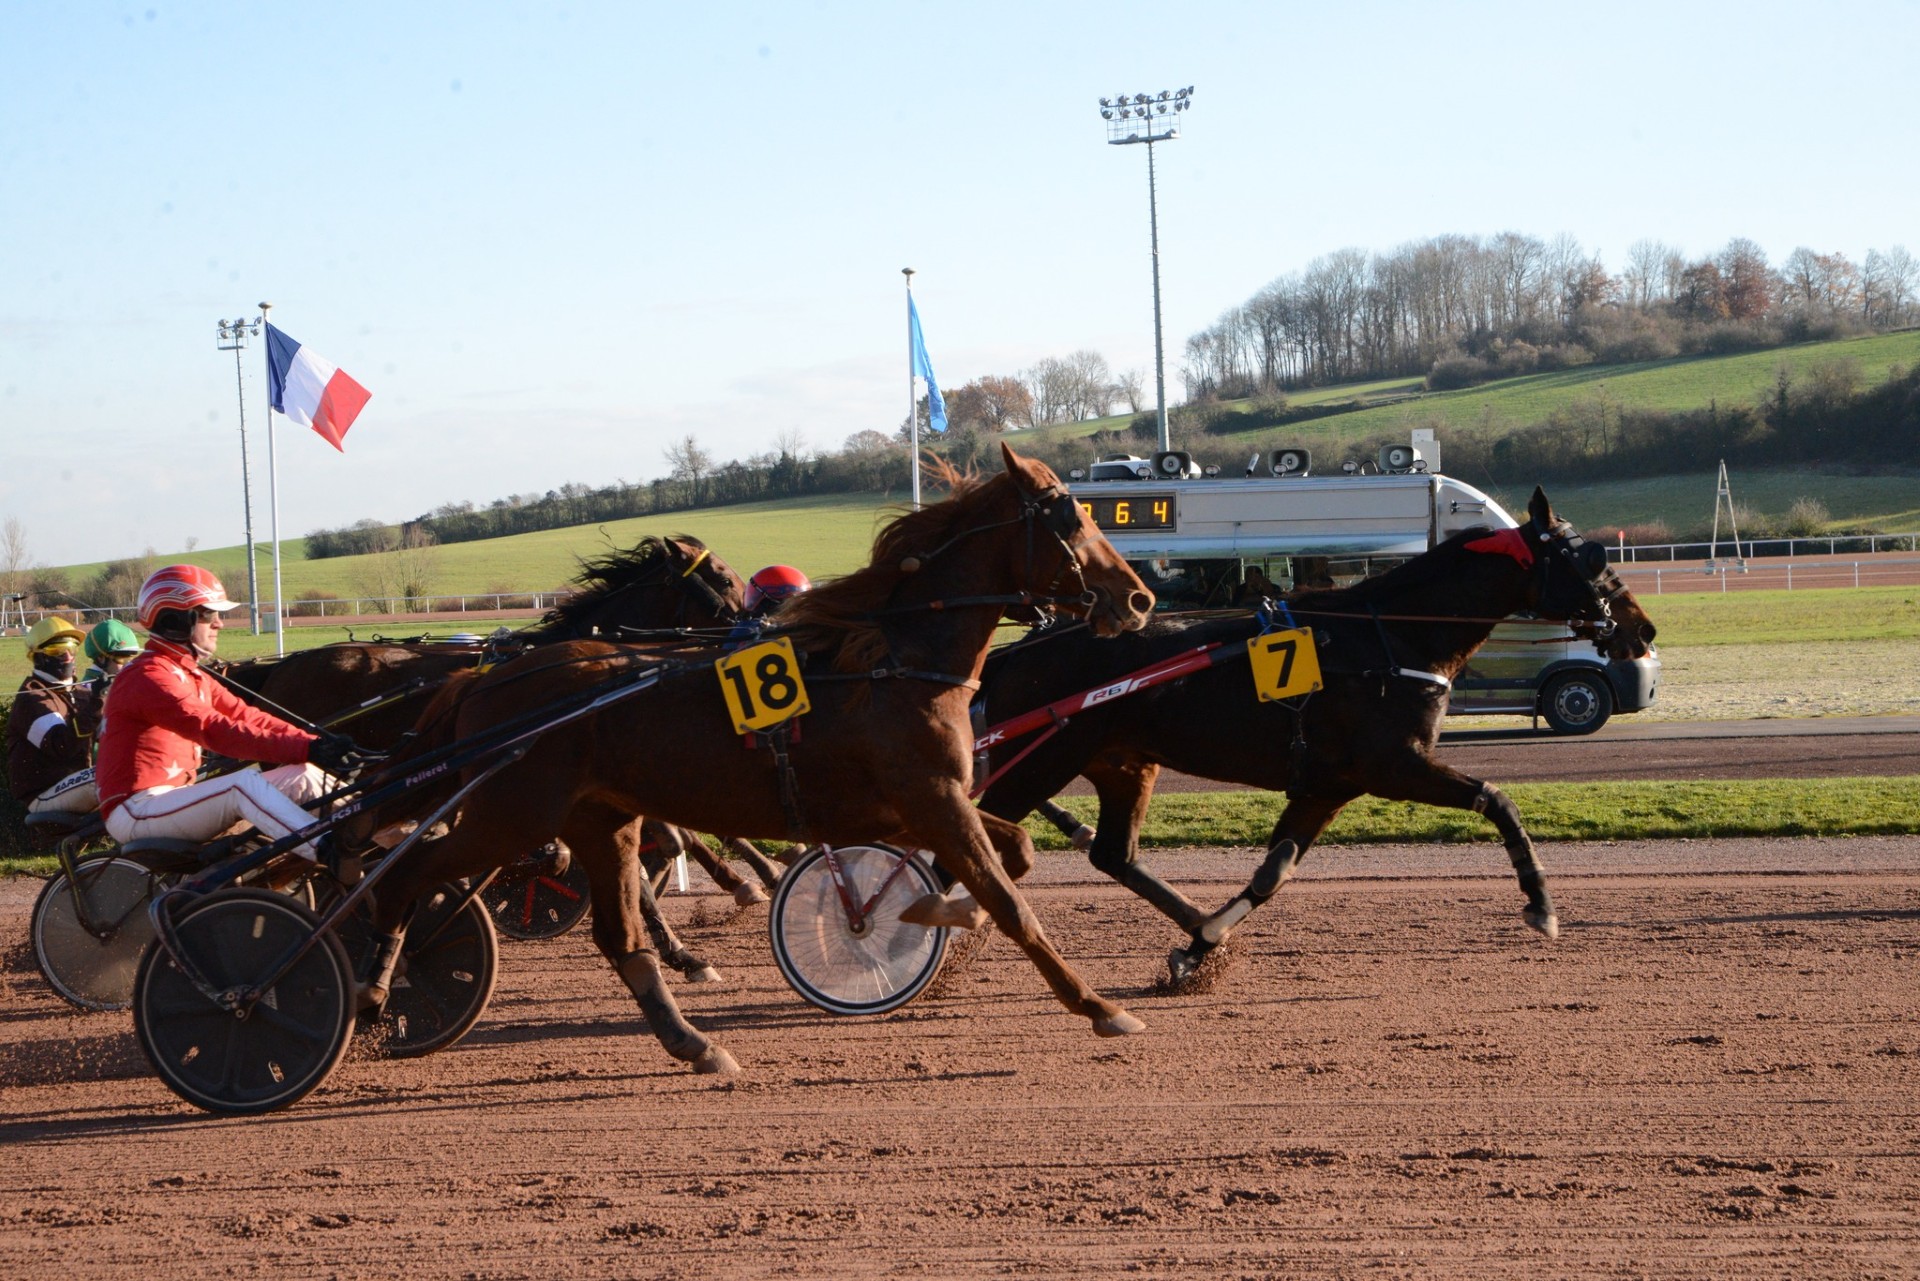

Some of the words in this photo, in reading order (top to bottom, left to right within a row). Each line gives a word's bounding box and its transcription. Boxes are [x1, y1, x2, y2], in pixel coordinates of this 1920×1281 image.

[1154, 501, 1168, 523] 4
[1267, 639, 1297, 689] 7
[723, 653, 798, 720] 18
[331, 807, 351, 822] FCS
